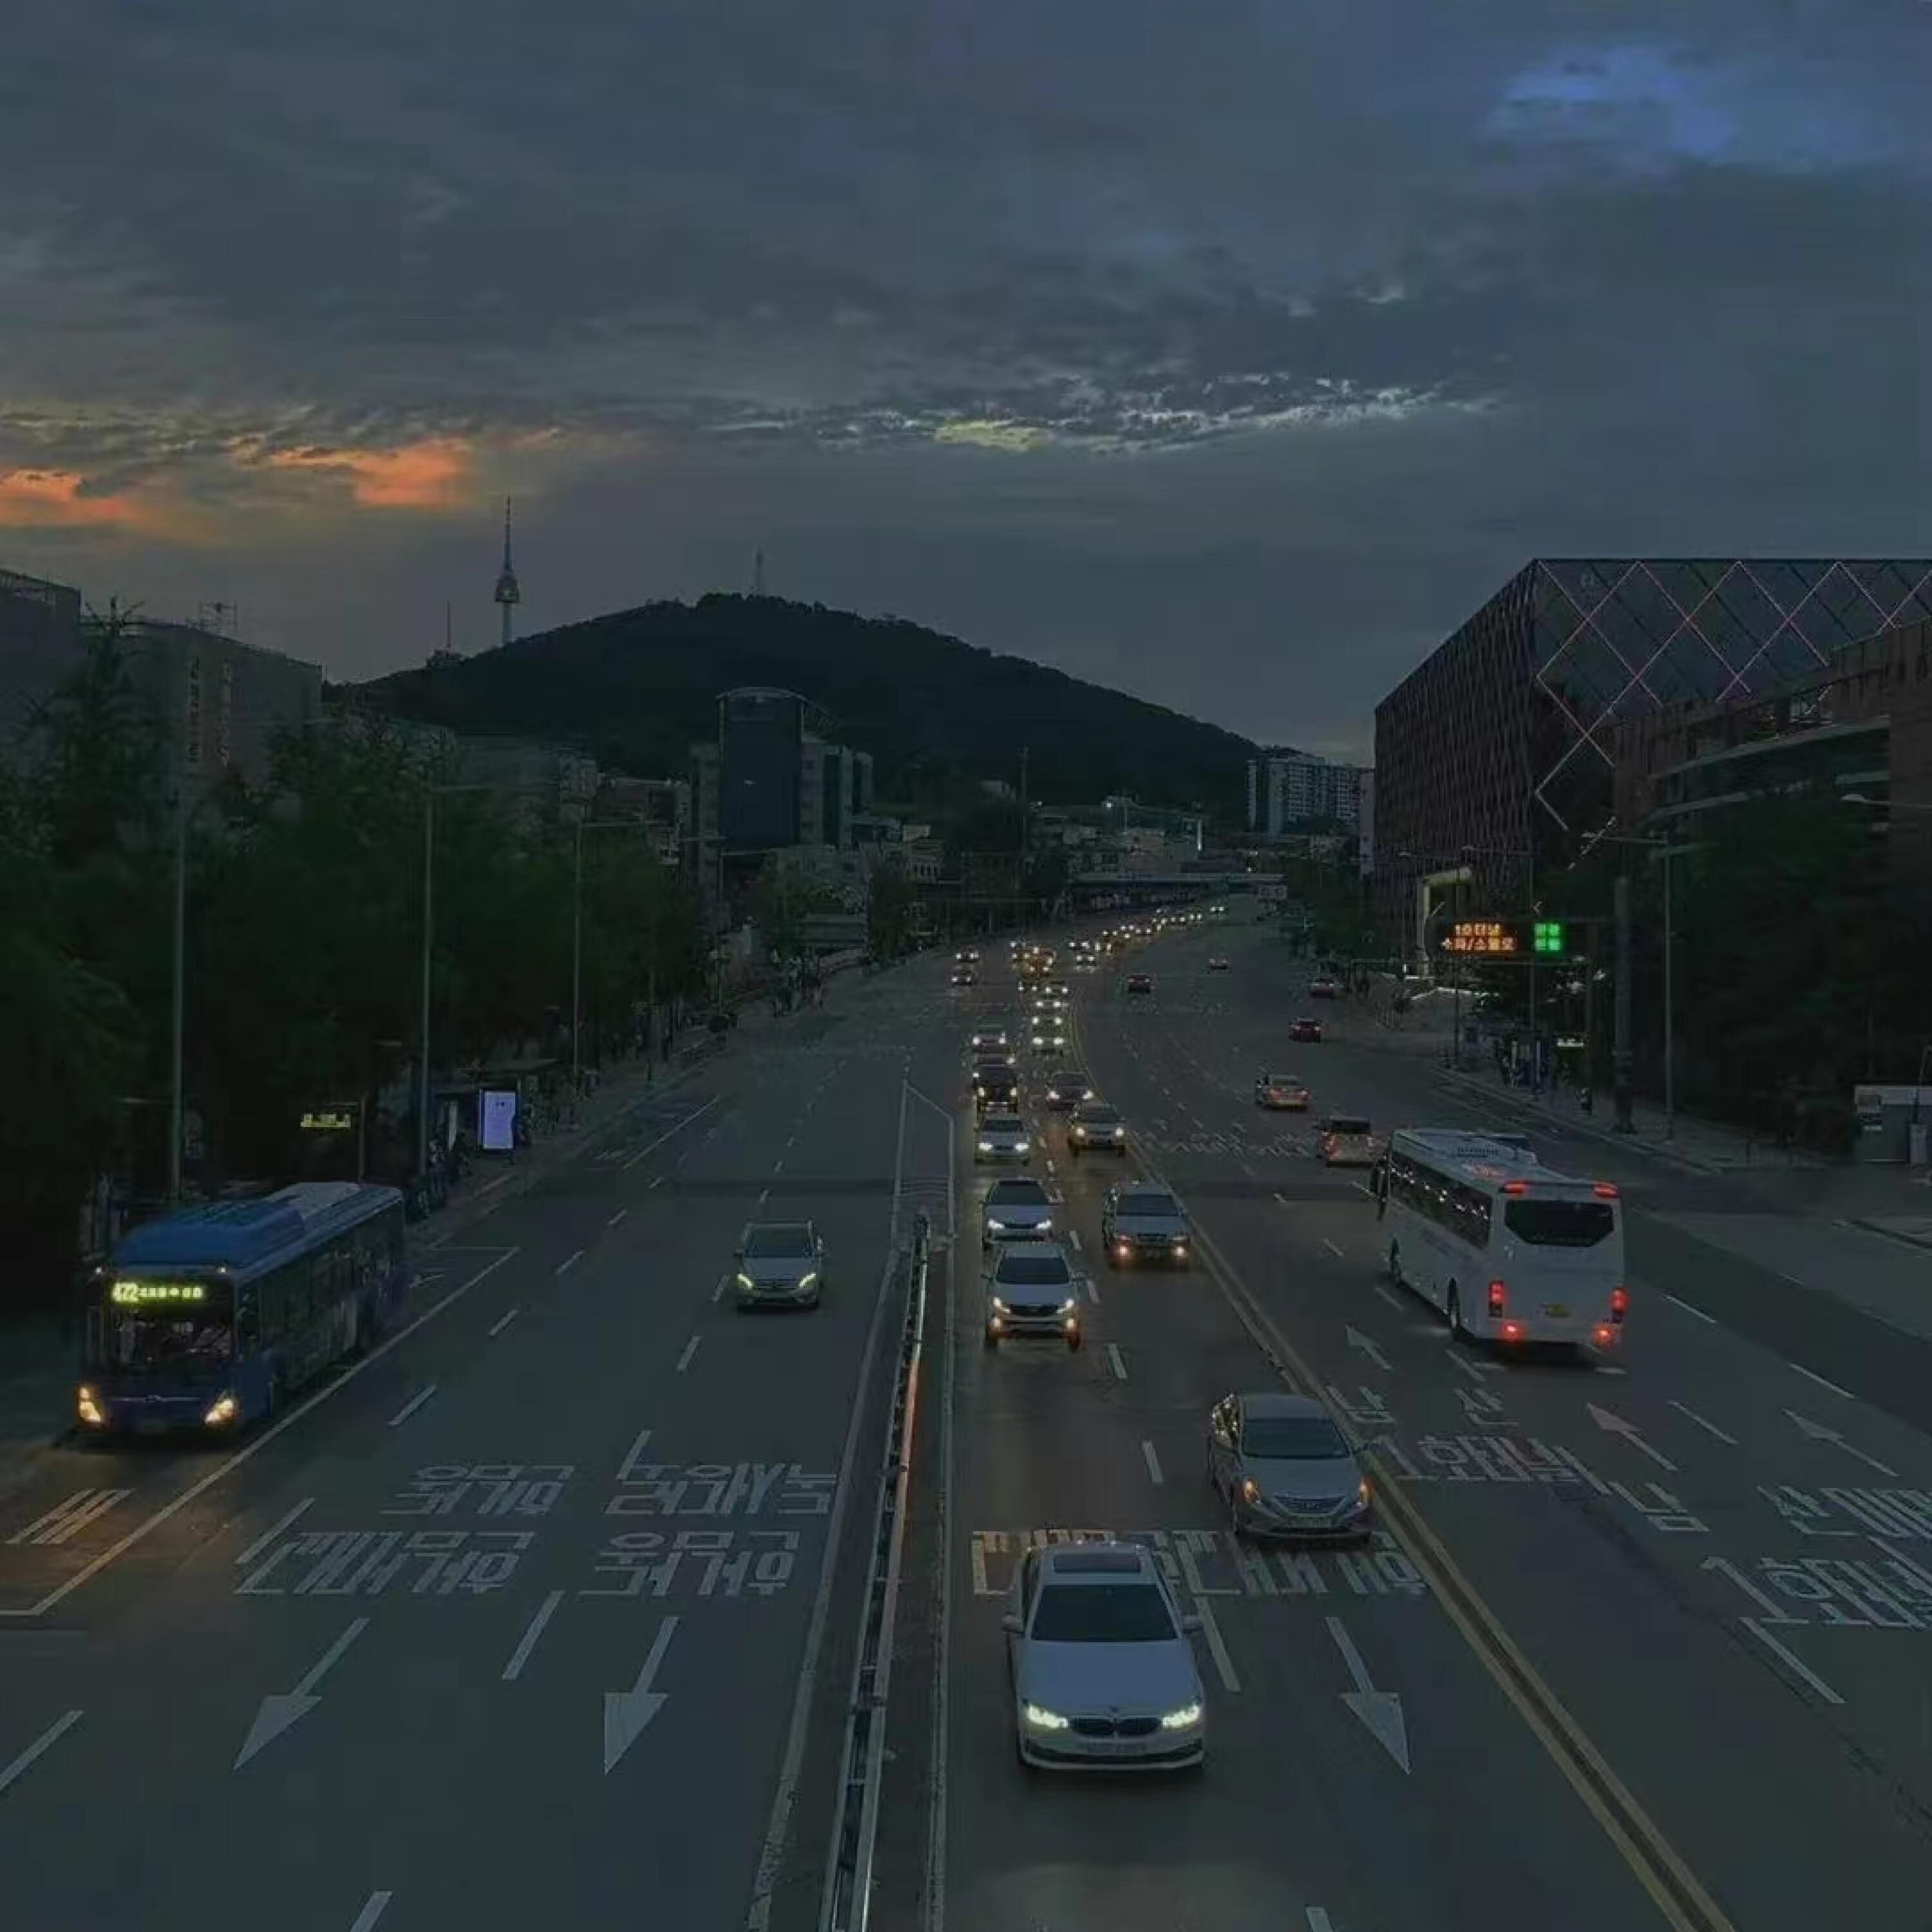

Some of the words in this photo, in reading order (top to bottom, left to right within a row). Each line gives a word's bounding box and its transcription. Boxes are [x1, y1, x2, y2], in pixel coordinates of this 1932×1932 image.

[381, 1464, 574, 1515] 한남동
[232, 1531, 535, 1595] 한남대교
[579, 1531, 800, 1596] 한남동
